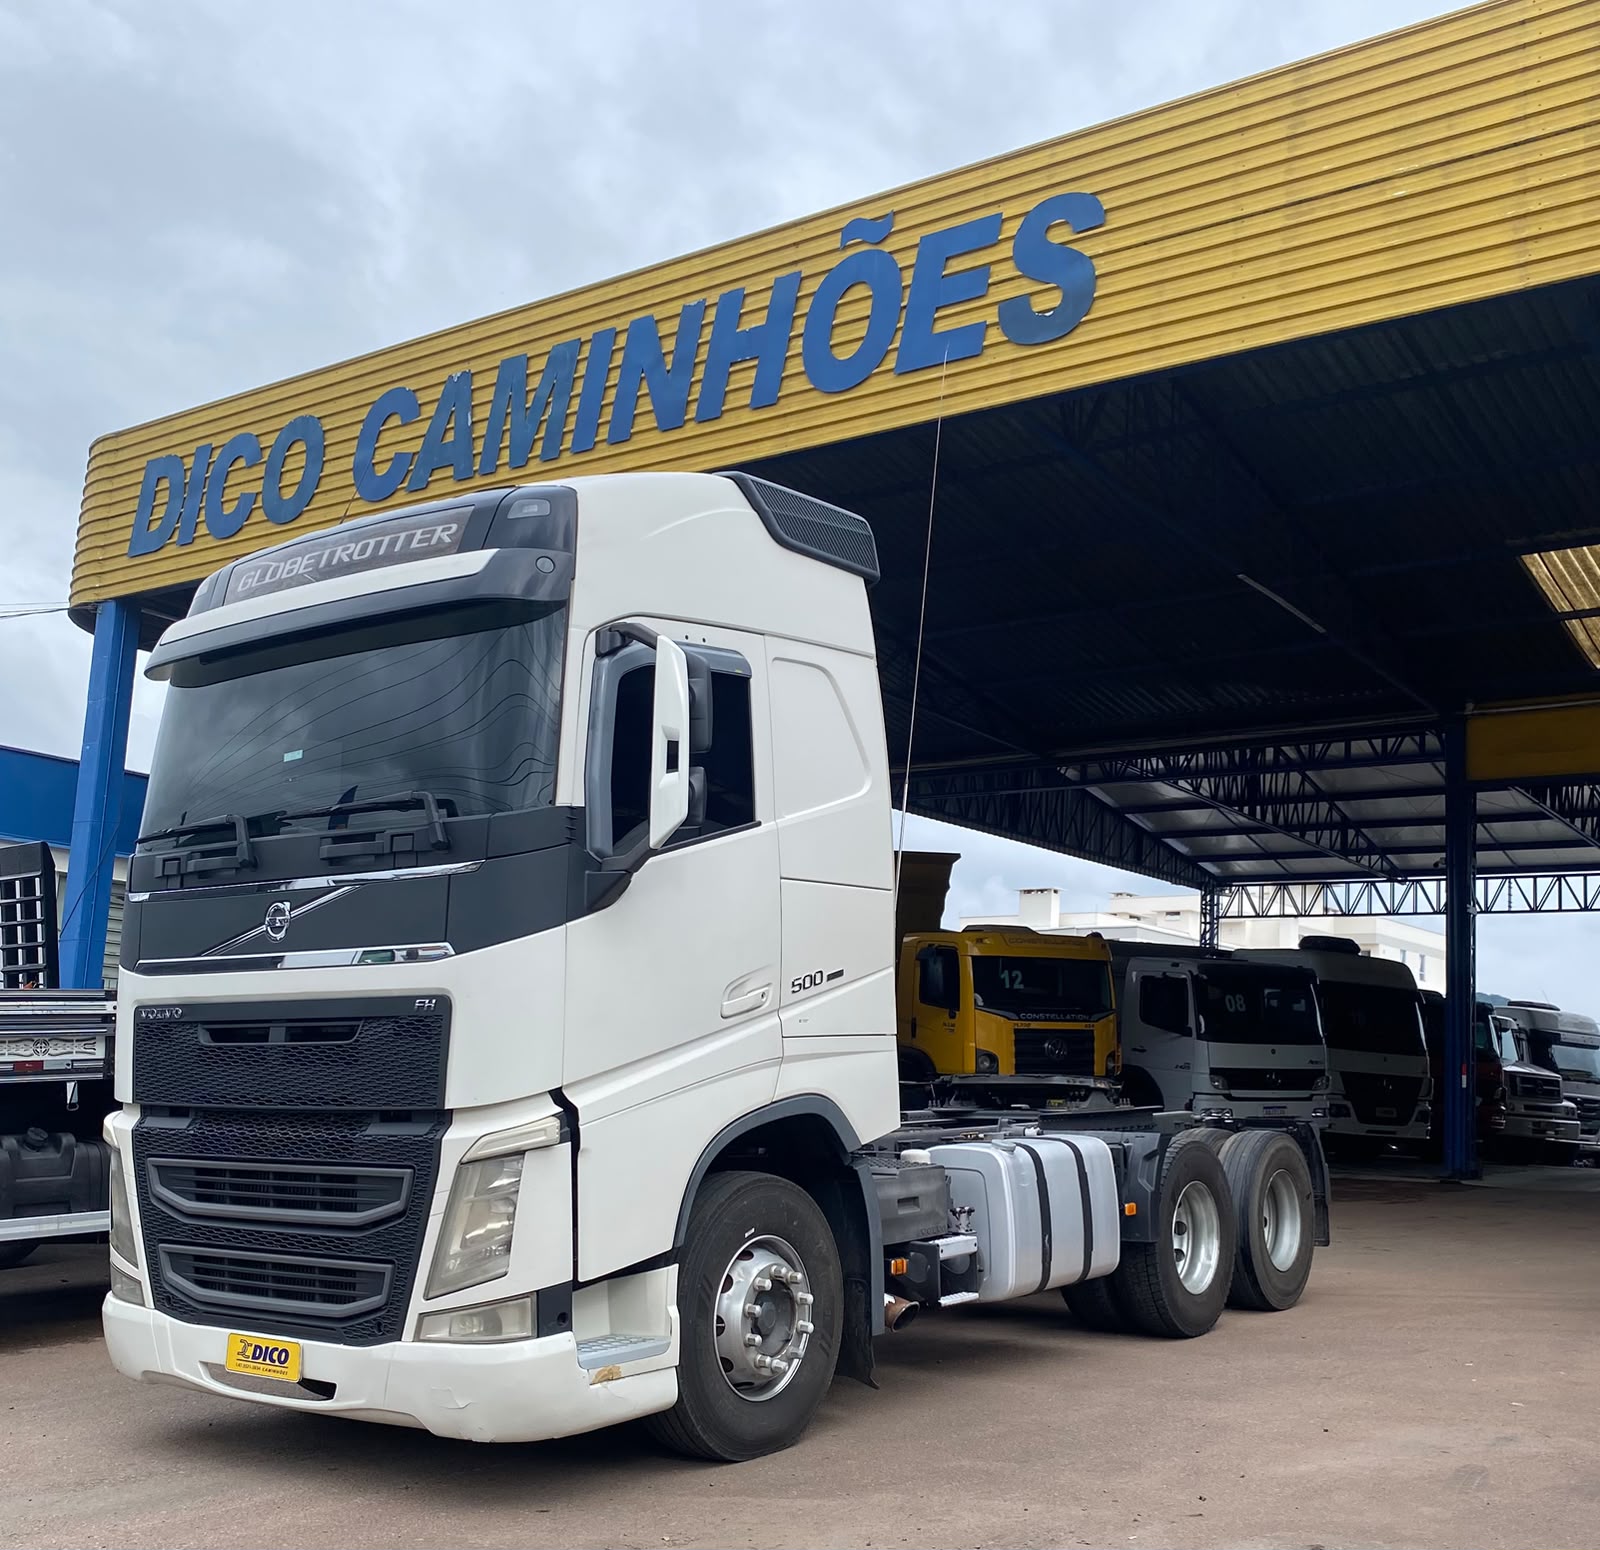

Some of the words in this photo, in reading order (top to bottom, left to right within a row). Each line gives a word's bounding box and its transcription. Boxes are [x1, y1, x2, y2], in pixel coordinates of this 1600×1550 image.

[128, 414, 325, 557] DICO
[353, 192, 1106, 502] CAMINHÕES
[237, 523, 458, 593] GLOBETROTTER
[791, 970, 824, 994] 500
[1001, 970, 1025, 989] 12
[414, 999, 436, 1011] FH
[1225, 994, 1246, 1012] 08
[1020, 1013, 1090, 1021] CONSTELLATION
[251, 1344, 289, 1365] DICO
